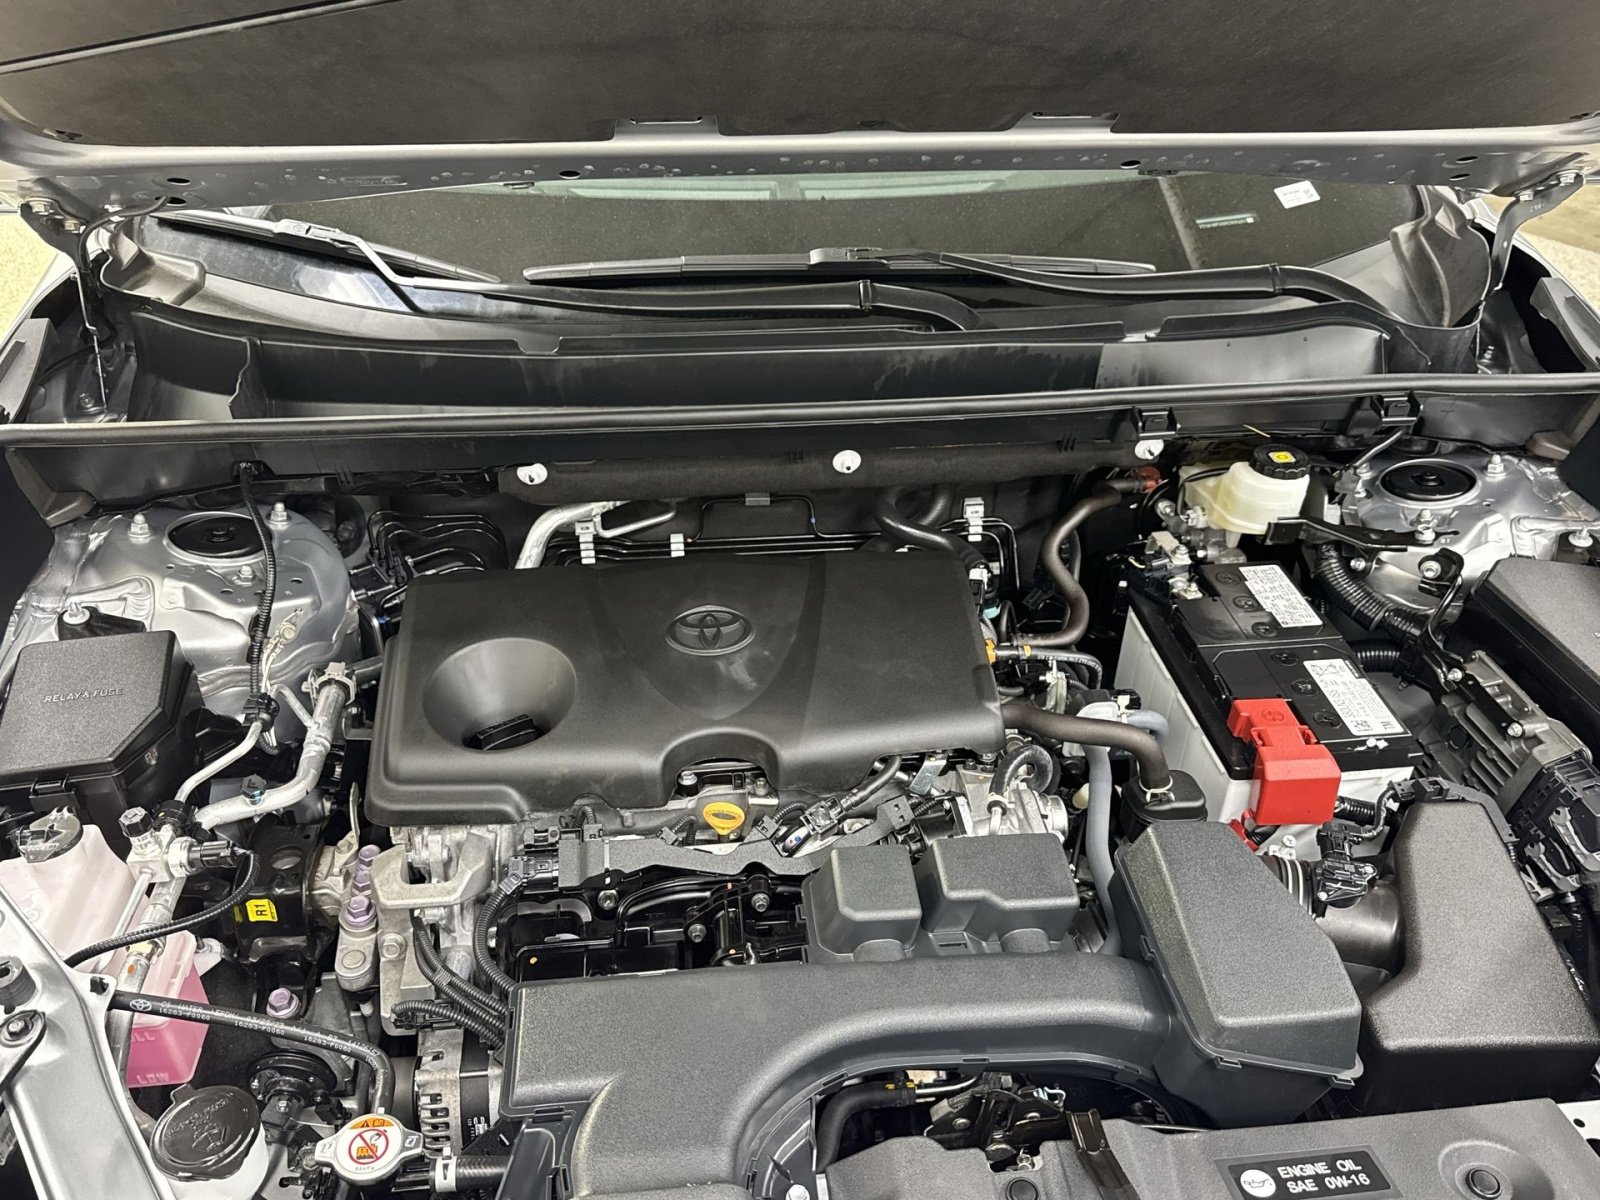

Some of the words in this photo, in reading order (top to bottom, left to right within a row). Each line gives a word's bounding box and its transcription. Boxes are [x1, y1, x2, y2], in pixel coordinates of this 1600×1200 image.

[44, 692, 82, 703] RELAY
[93, 687, 125, 698] FUSE
[255, 904, 268, 915] R1
[136, 1072, 170, 1084] LOW
[1277, 1161, 1331, 1179] ENGINE
[1336, 1159, 1362, 1172] OIL
[1286, 1179, 1319, 1194] SAE
[1324, 1173, 1371, 1190] 0W-16
